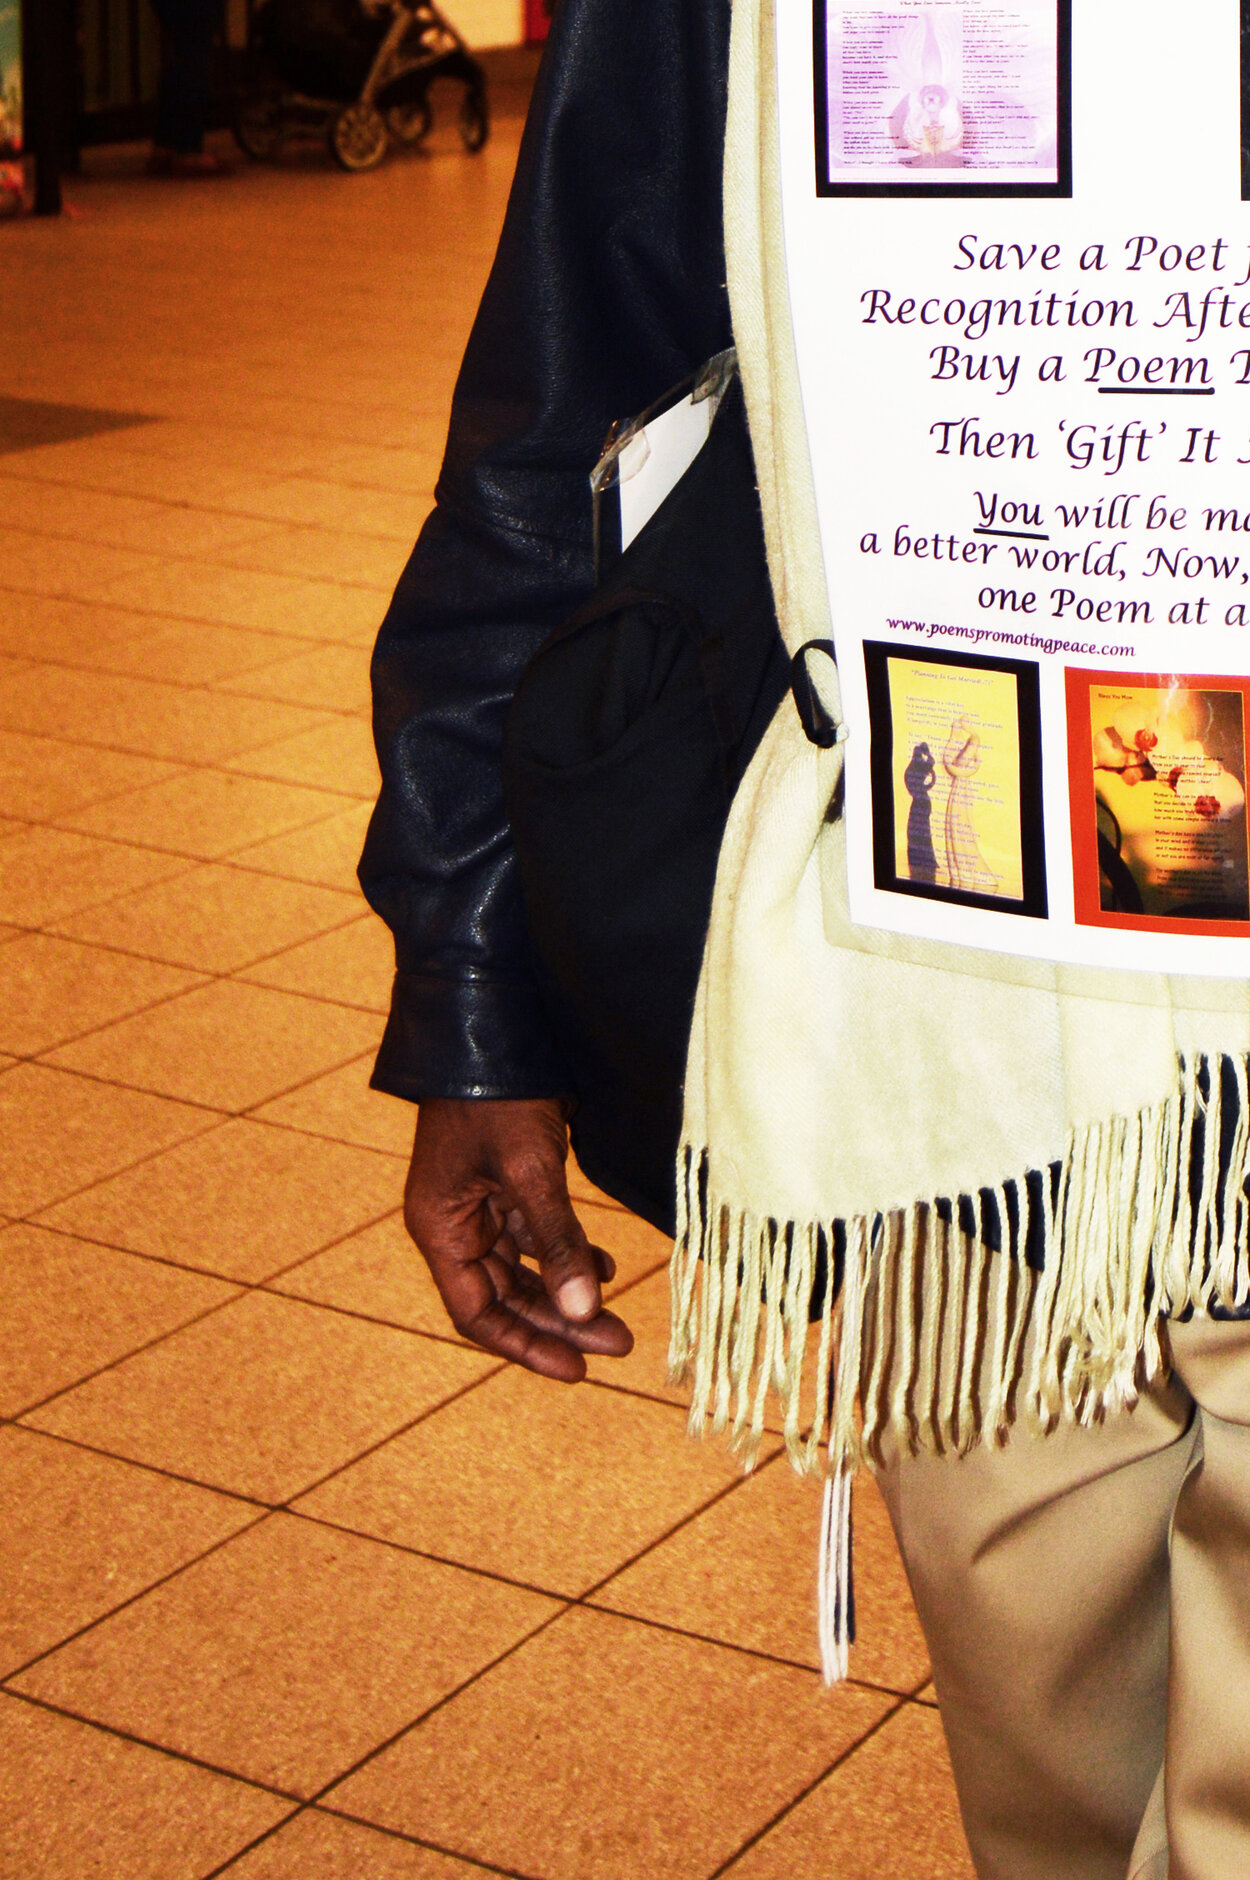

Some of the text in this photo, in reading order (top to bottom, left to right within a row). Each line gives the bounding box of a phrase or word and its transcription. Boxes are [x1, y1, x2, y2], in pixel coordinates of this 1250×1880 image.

[953, 234, 1061, 271] Save
[1079, 244, 1108, 271] a
[1124, 236, 1229, 272] Poet
[860, 289, 1138, 340] Recognition
[929, 345, 1021, 394] Buy
[1038, 355, 1067, 382] a
[1083, 347, 1214, 385] Poem
[929, 417, 1039, 461] Then
[1179, 427, 1222, 463] It
[973, 491, 1045, 529] You
[1054, 494, 1140, 530] will
[1145, 494, 1188, 532] be
[859, 532, 882, 554] a
[893, 524, 1001, 565] better
[1008, 540, 1128, 579] world,
[1142, 547, 1250, 585] Now,
[978, 587, 1038, 614] one
[1050, 588, 1152, 625] Poem
[1168, 597, 1211, 625] at
[1224, 604, 1248, 627] a
[886, 618, 1136, 658] www.poemspromotingpeace.com
